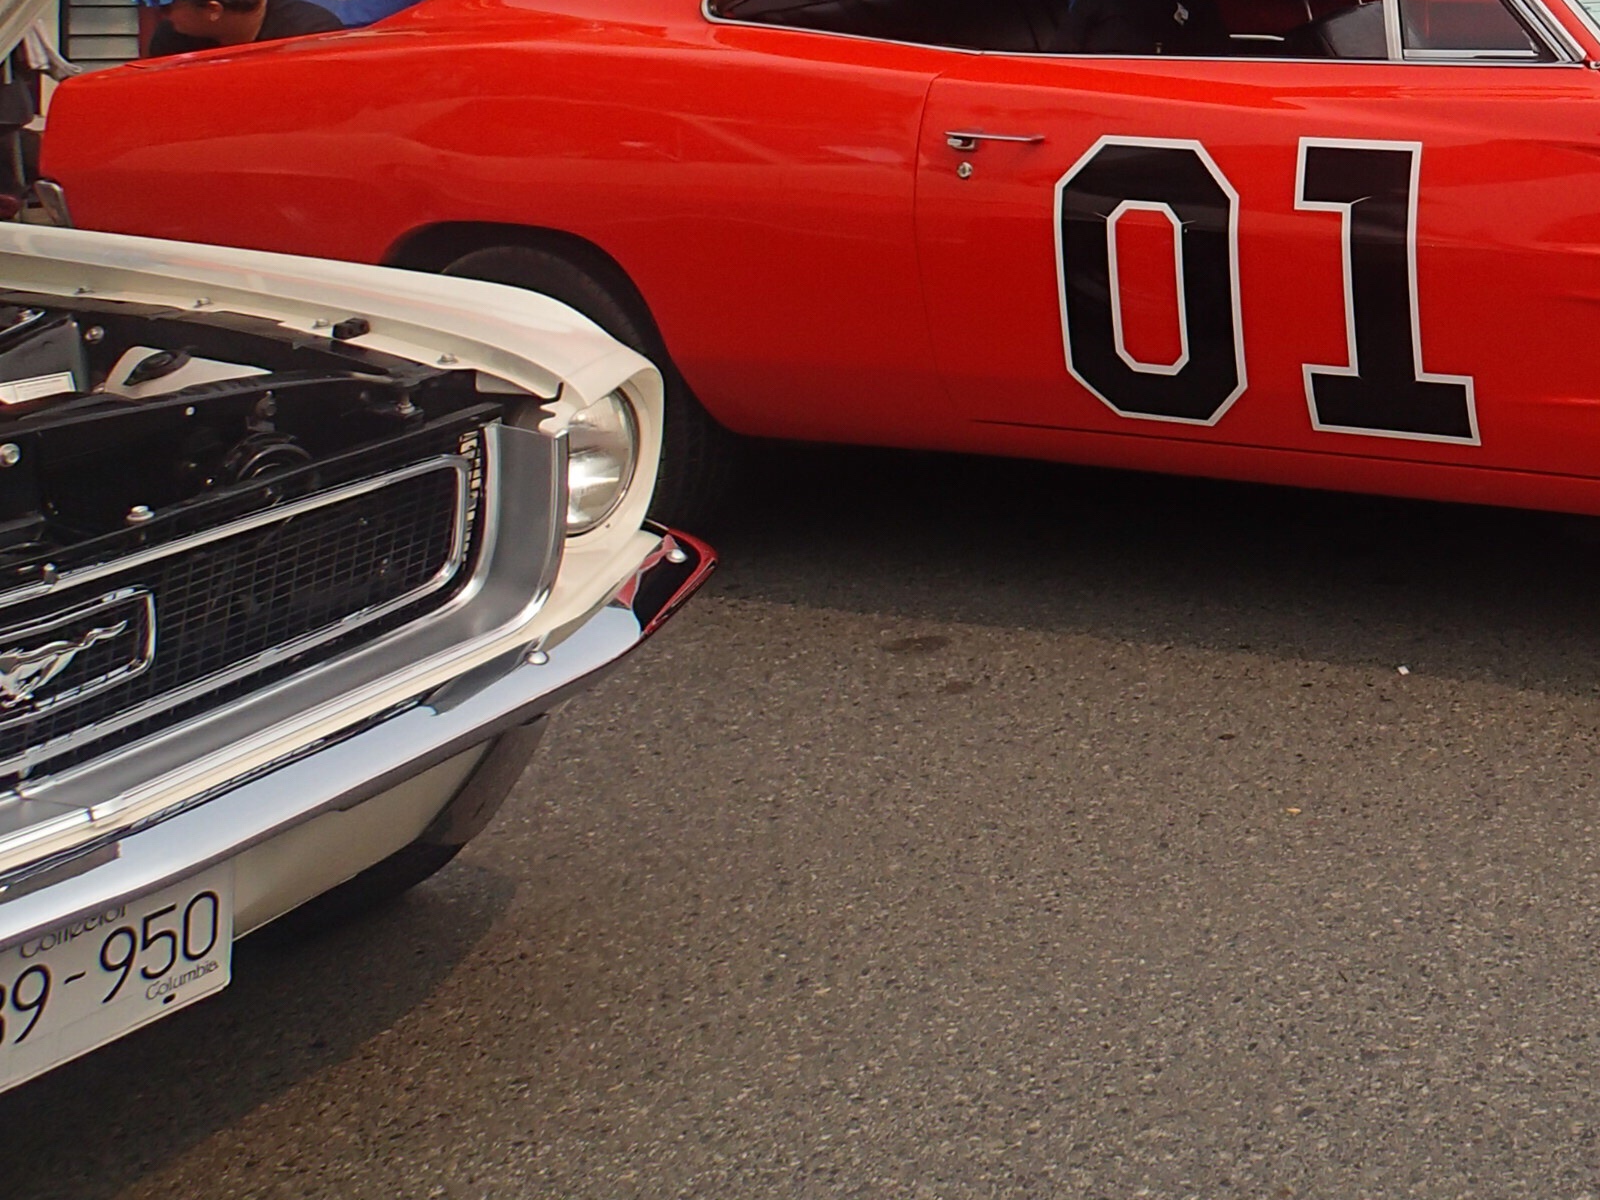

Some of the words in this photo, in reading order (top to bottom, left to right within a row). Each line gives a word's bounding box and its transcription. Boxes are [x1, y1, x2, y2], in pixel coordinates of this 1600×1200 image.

[1053, 135, 1482, 446] 01
[0, 890, 219, 1046] 9-950
[146, 959, 219, 1001] Columbia
